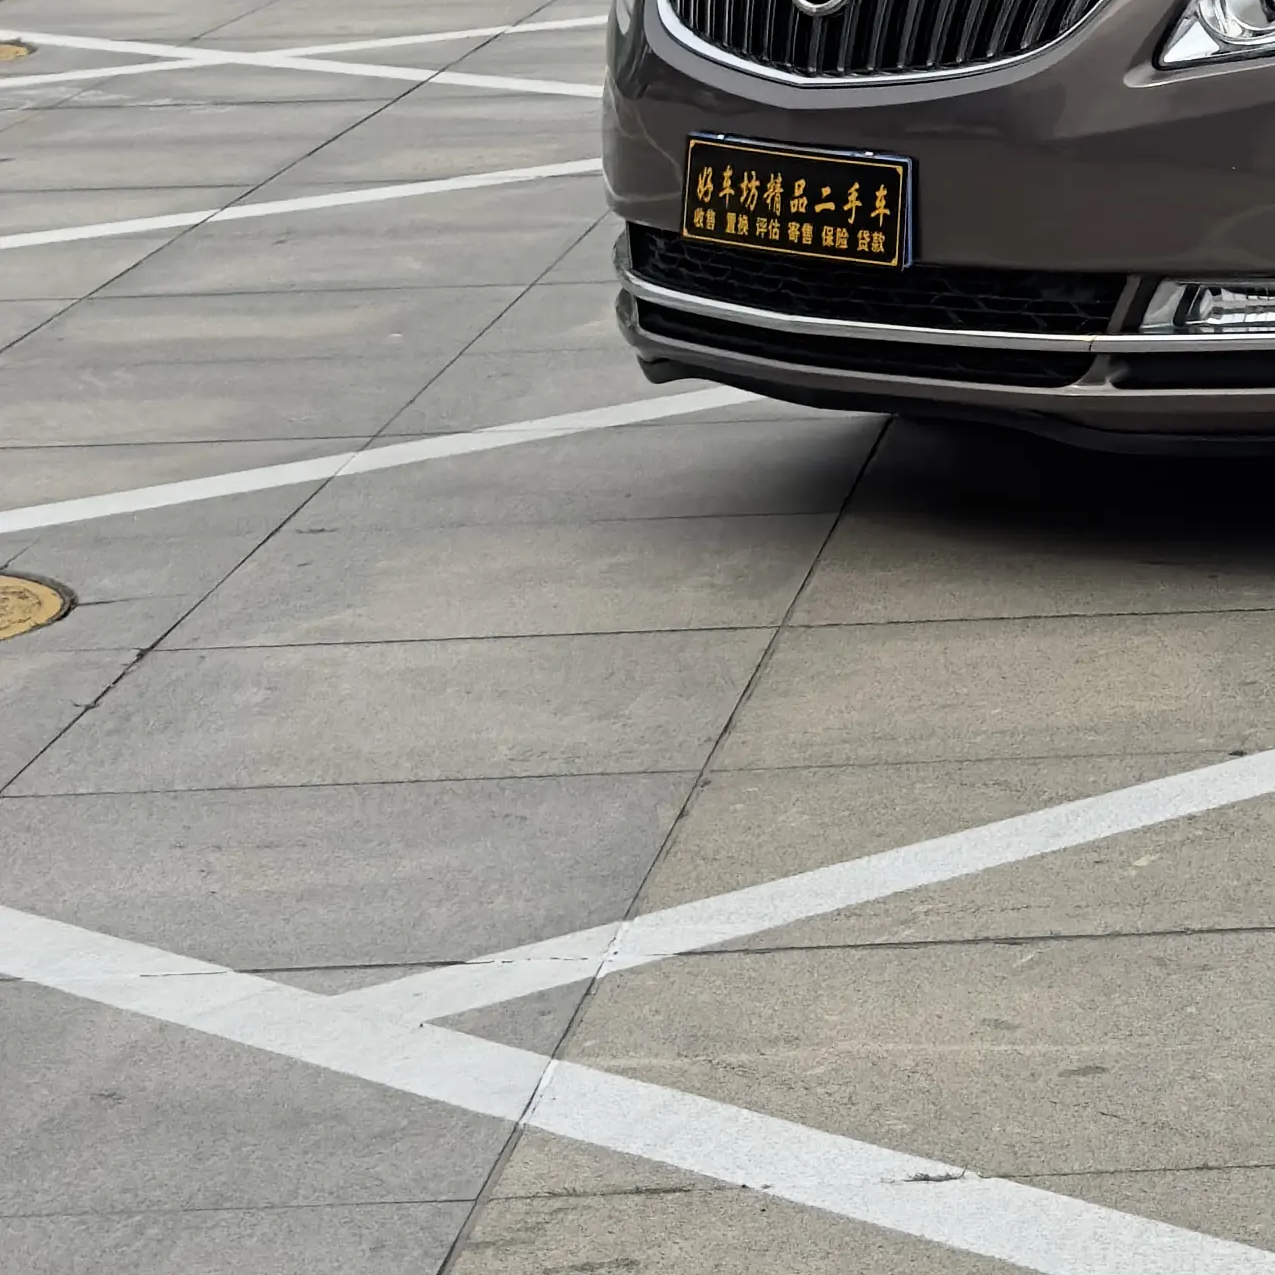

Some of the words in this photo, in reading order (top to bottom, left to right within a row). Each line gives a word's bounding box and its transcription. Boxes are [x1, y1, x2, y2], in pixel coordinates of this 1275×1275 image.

[696, 164, 891, 227] 好车坊精品二手车
[693, 207, 716, 231] 收售
[725, 212, 749, 236] 置换
[755, 216, 781, 241] 评估
[787, 221, 814, 245] 寄售
[821, 225, 849, 249] 保险
[856, 229, 886, 253] 贷款
